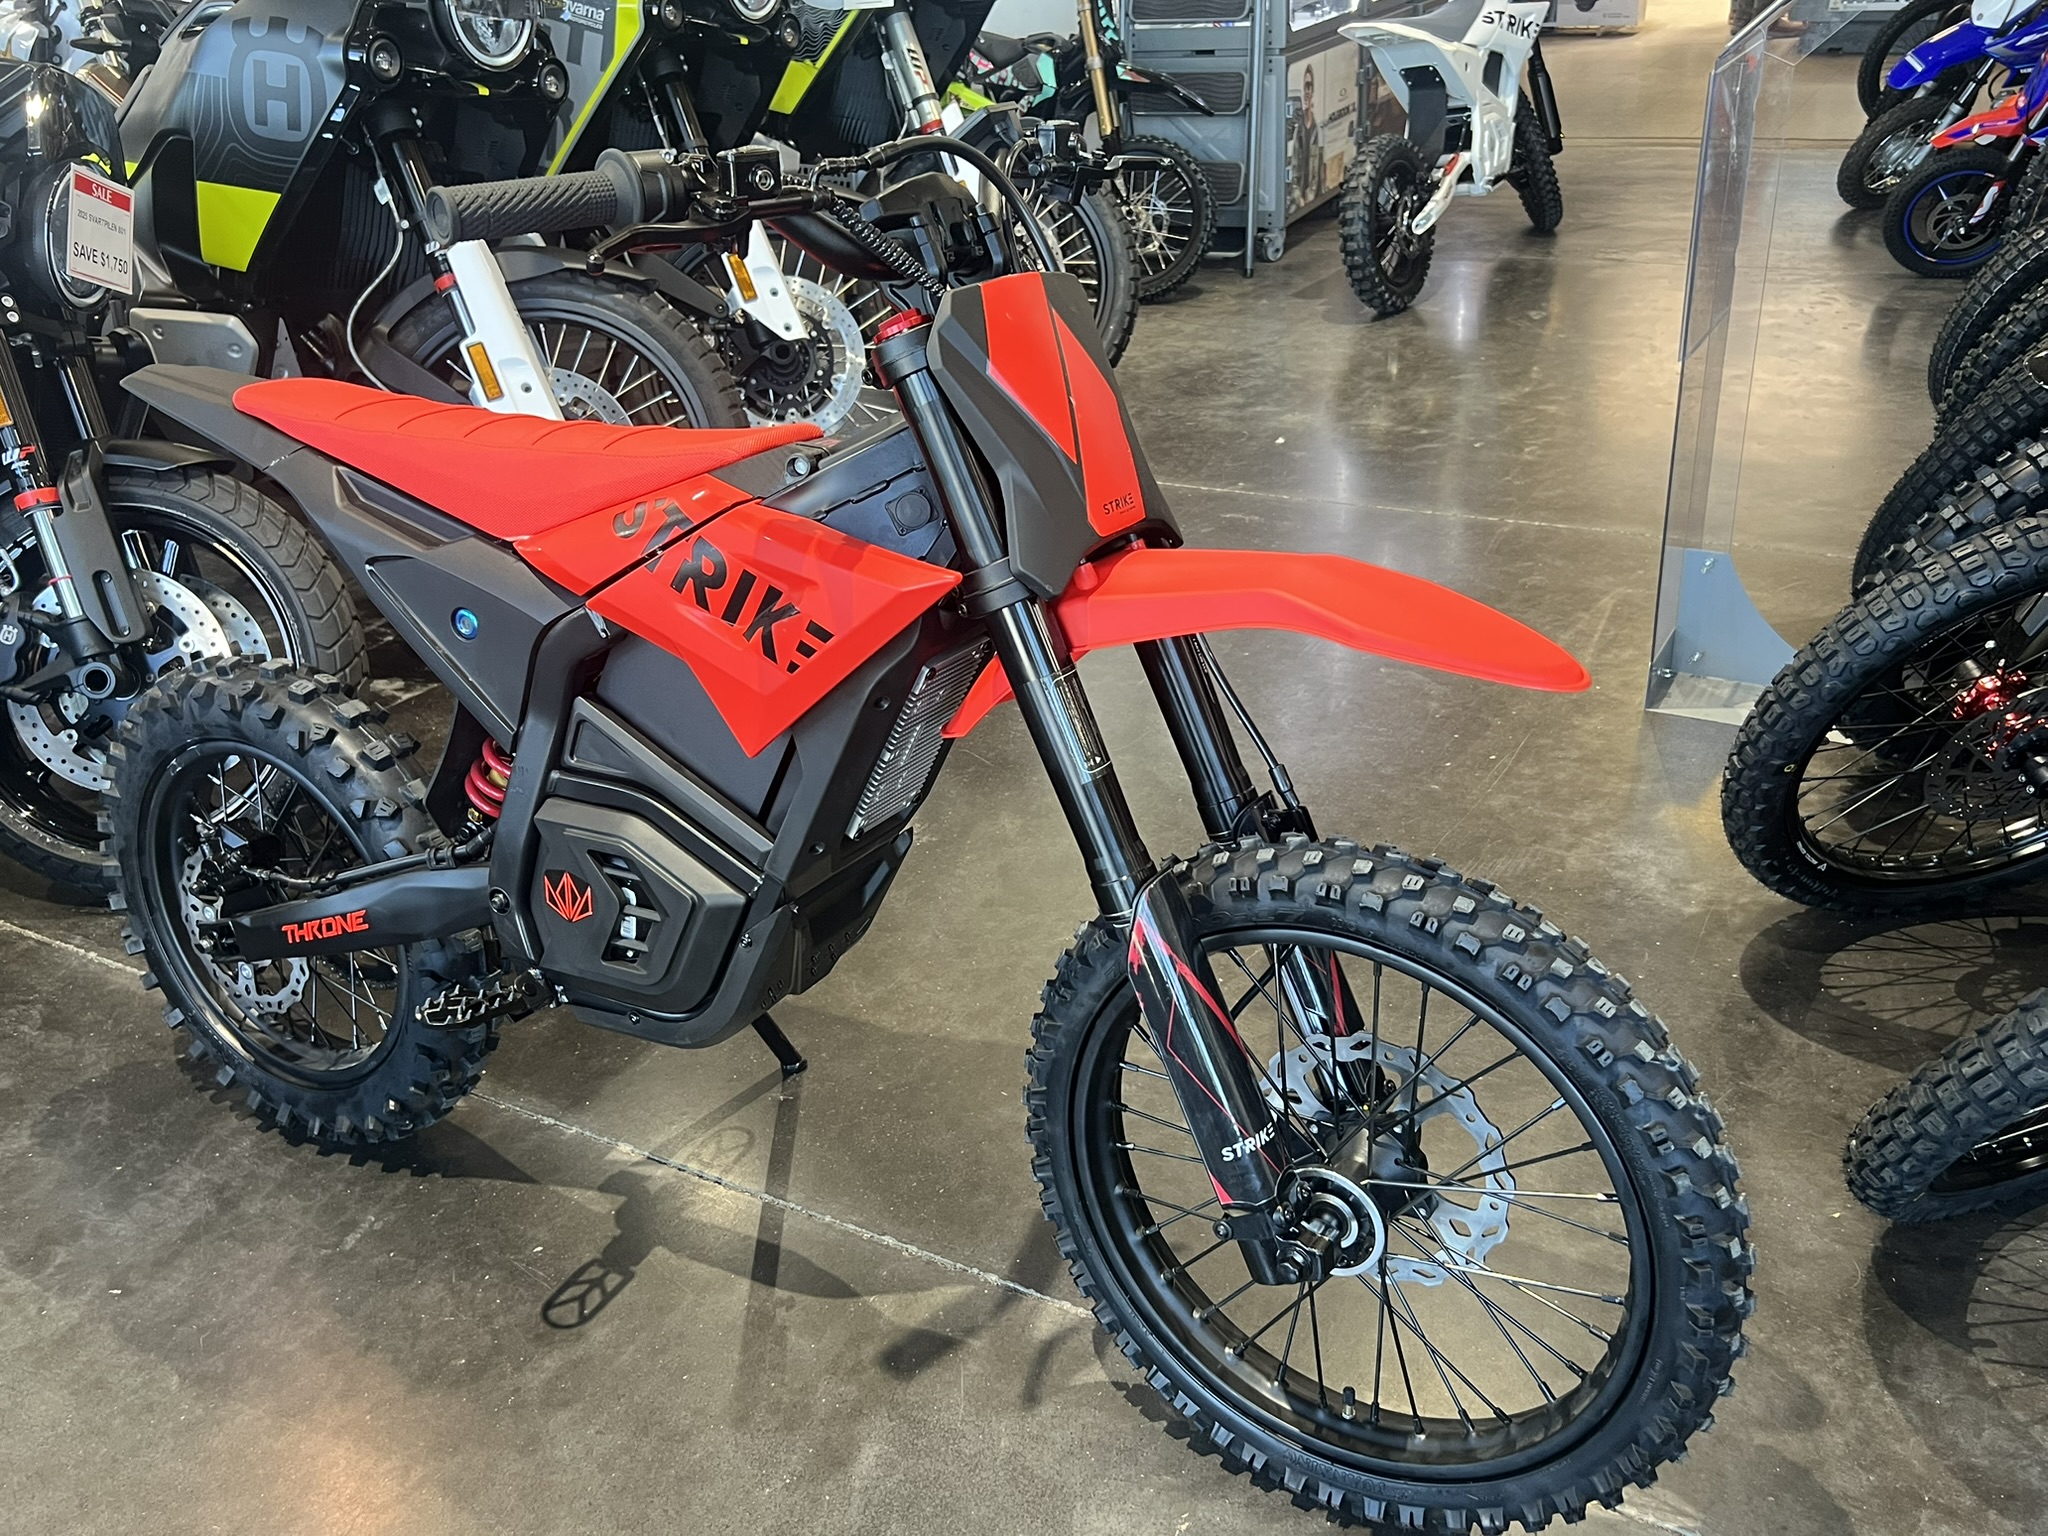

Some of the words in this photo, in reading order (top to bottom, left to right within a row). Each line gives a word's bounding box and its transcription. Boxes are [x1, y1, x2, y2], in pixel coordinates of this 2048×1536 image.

[1482, 11, 1540, 39] STRIKE
[91, 183, 113, 204] SALE
[73, 241, 98, 264] SAVE
[100, 251, 128, 275] $1,750
[1103, 492, 1134, 515] STRIKE
[612, 497, 835, 675] STRIKE
[281, 909, 369, 944] THRONE
[1221, 1121, 1275, 1162] STRIKE
